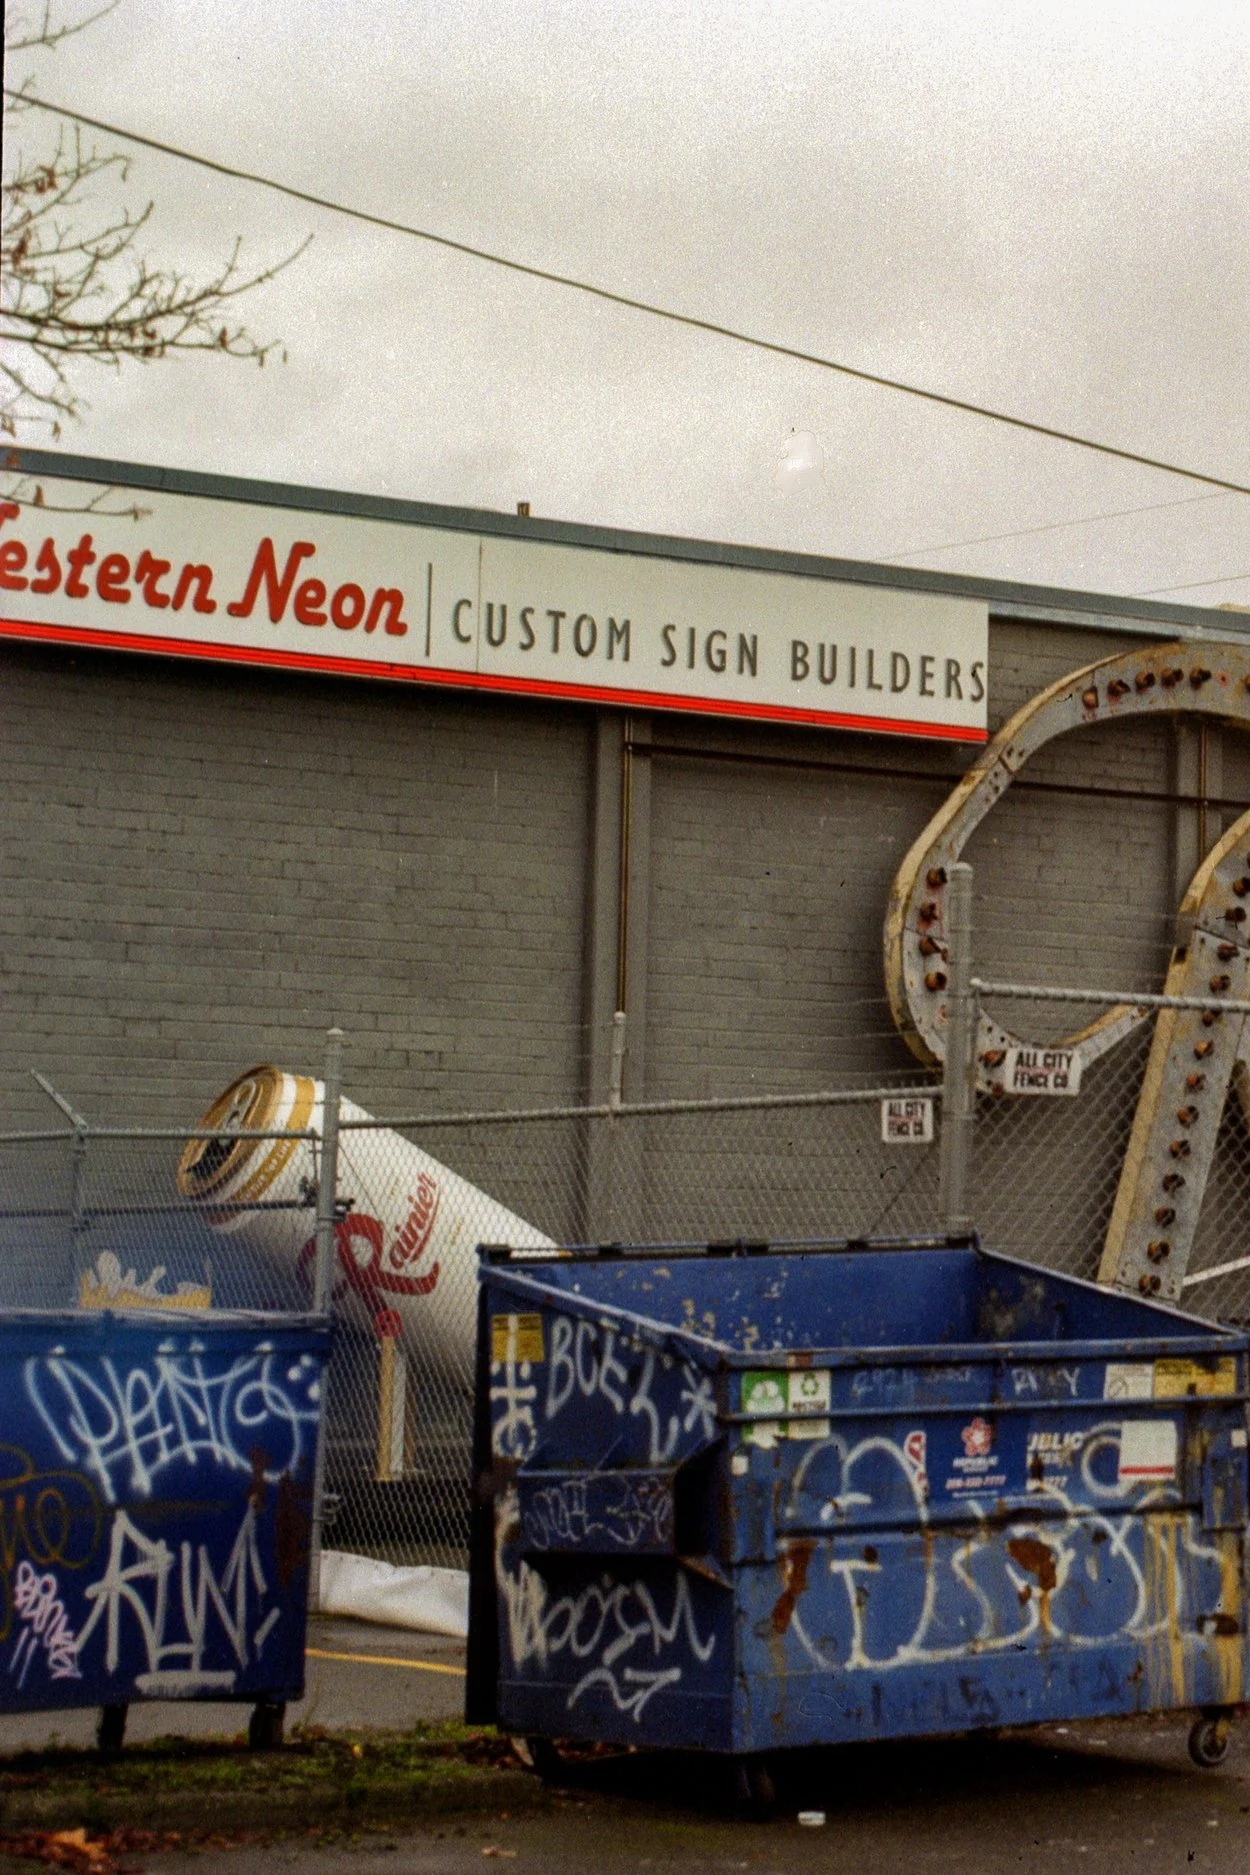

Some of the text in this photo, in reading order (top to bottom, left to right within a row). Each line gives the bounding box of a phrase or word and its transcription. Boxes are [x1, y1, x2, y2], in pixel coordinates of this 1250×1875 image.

[0, 502, 408, 636] estern Neon
[453, 599, 986, 702] CUSTOM SIGN BUILDERS
[1015, 1051, 1074, 1068] ALL CITY
[1013, 1071, 1048, 1088] FENCE
[905, 1102, 926, 1117] CITY
